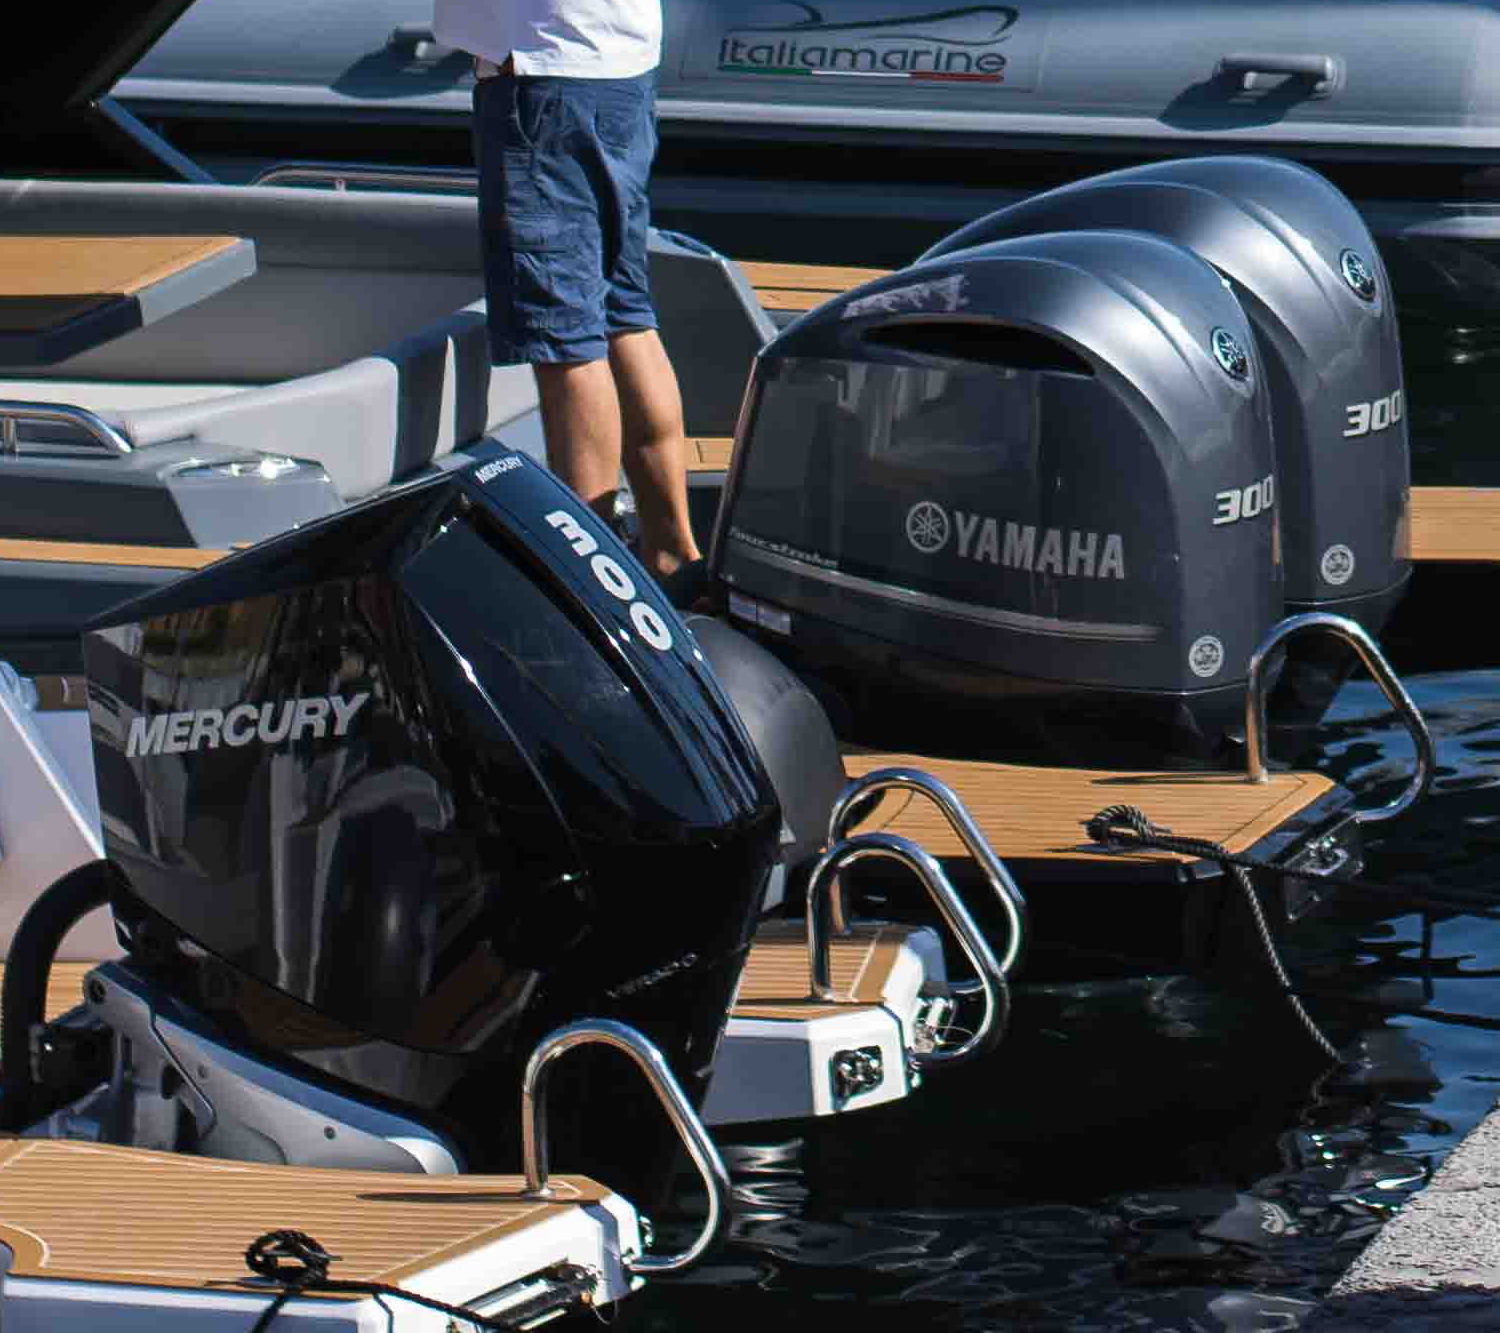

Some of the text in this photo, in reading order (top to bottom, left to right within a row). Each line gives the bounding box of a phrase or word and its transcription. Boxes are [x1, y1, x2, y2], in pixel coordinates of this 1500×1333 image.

[1343, 388, 1401, 438] 300
[474, 455, 524, 484] MERCURY
[1212, 473, 1274, 525] 300
[954, 510, 1126, 581] YAMAHA
[544, 510, 673, 651] 300
[125, 693, 371, 758] MERCURY
